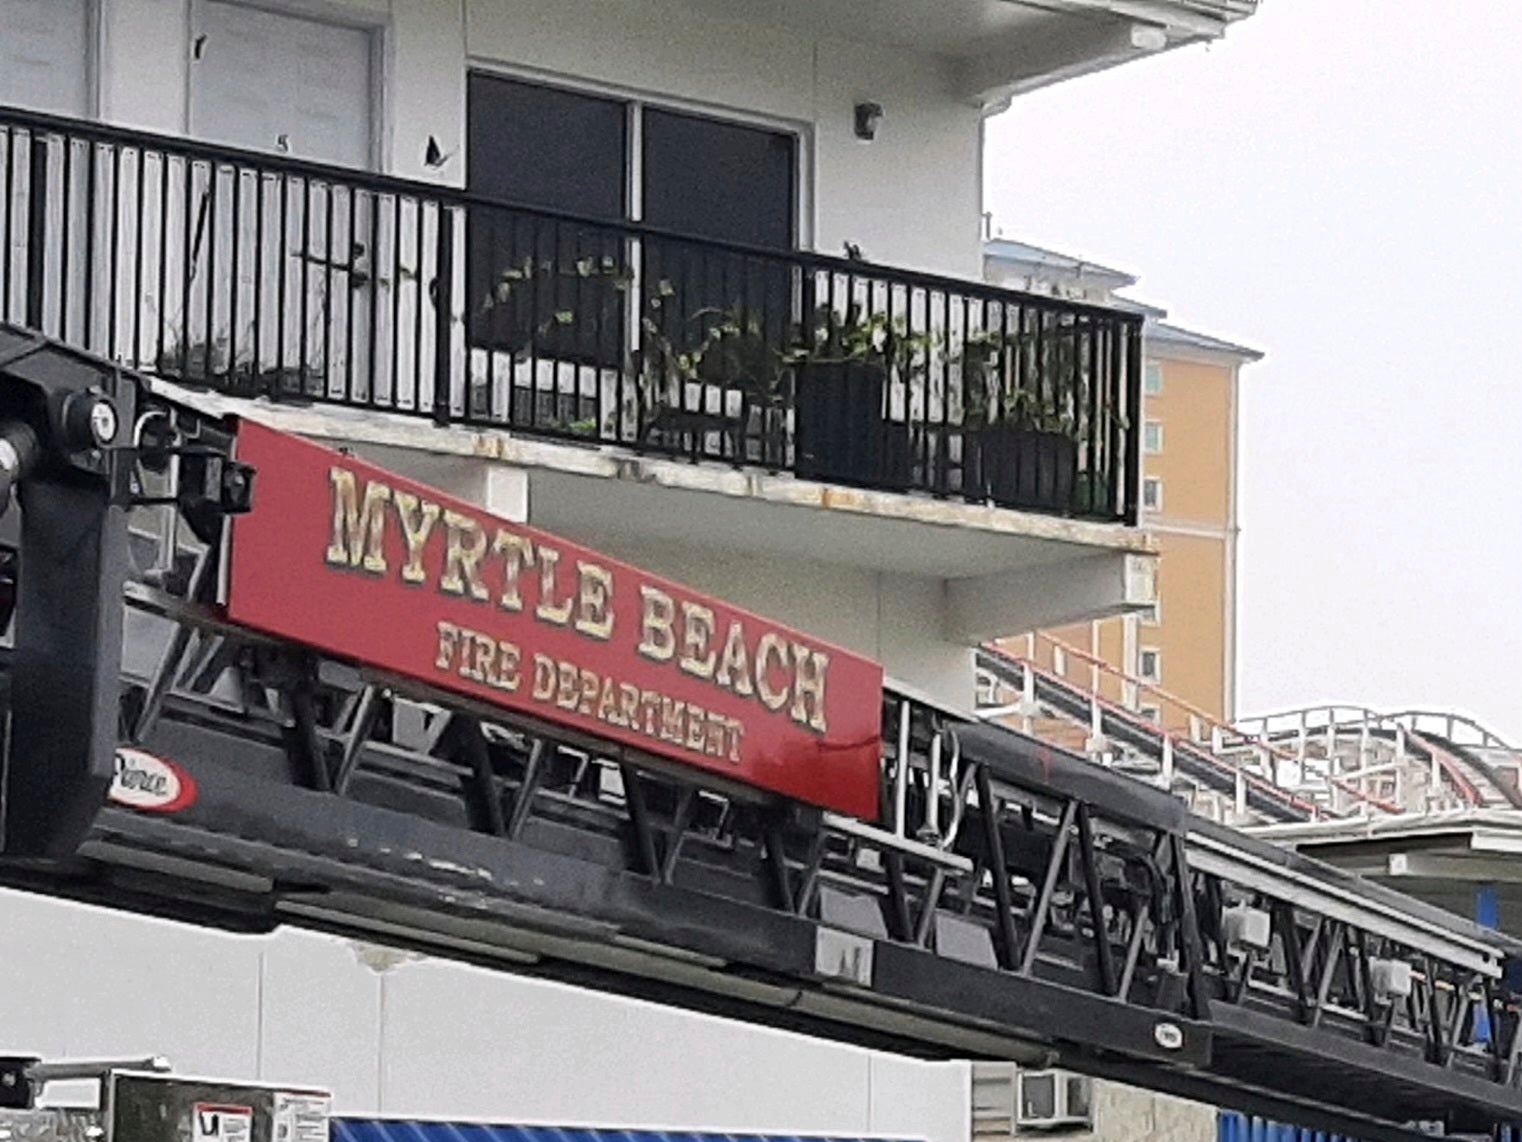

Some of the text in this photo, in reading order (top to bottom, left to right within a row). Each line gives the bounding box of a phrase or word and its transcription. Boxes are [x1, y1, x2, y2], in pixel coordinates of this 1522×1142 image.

[325, 465, 831, 736] MYRTLE BEACH
[434, 620, 745, 764] FIRE DEPARTMENT
